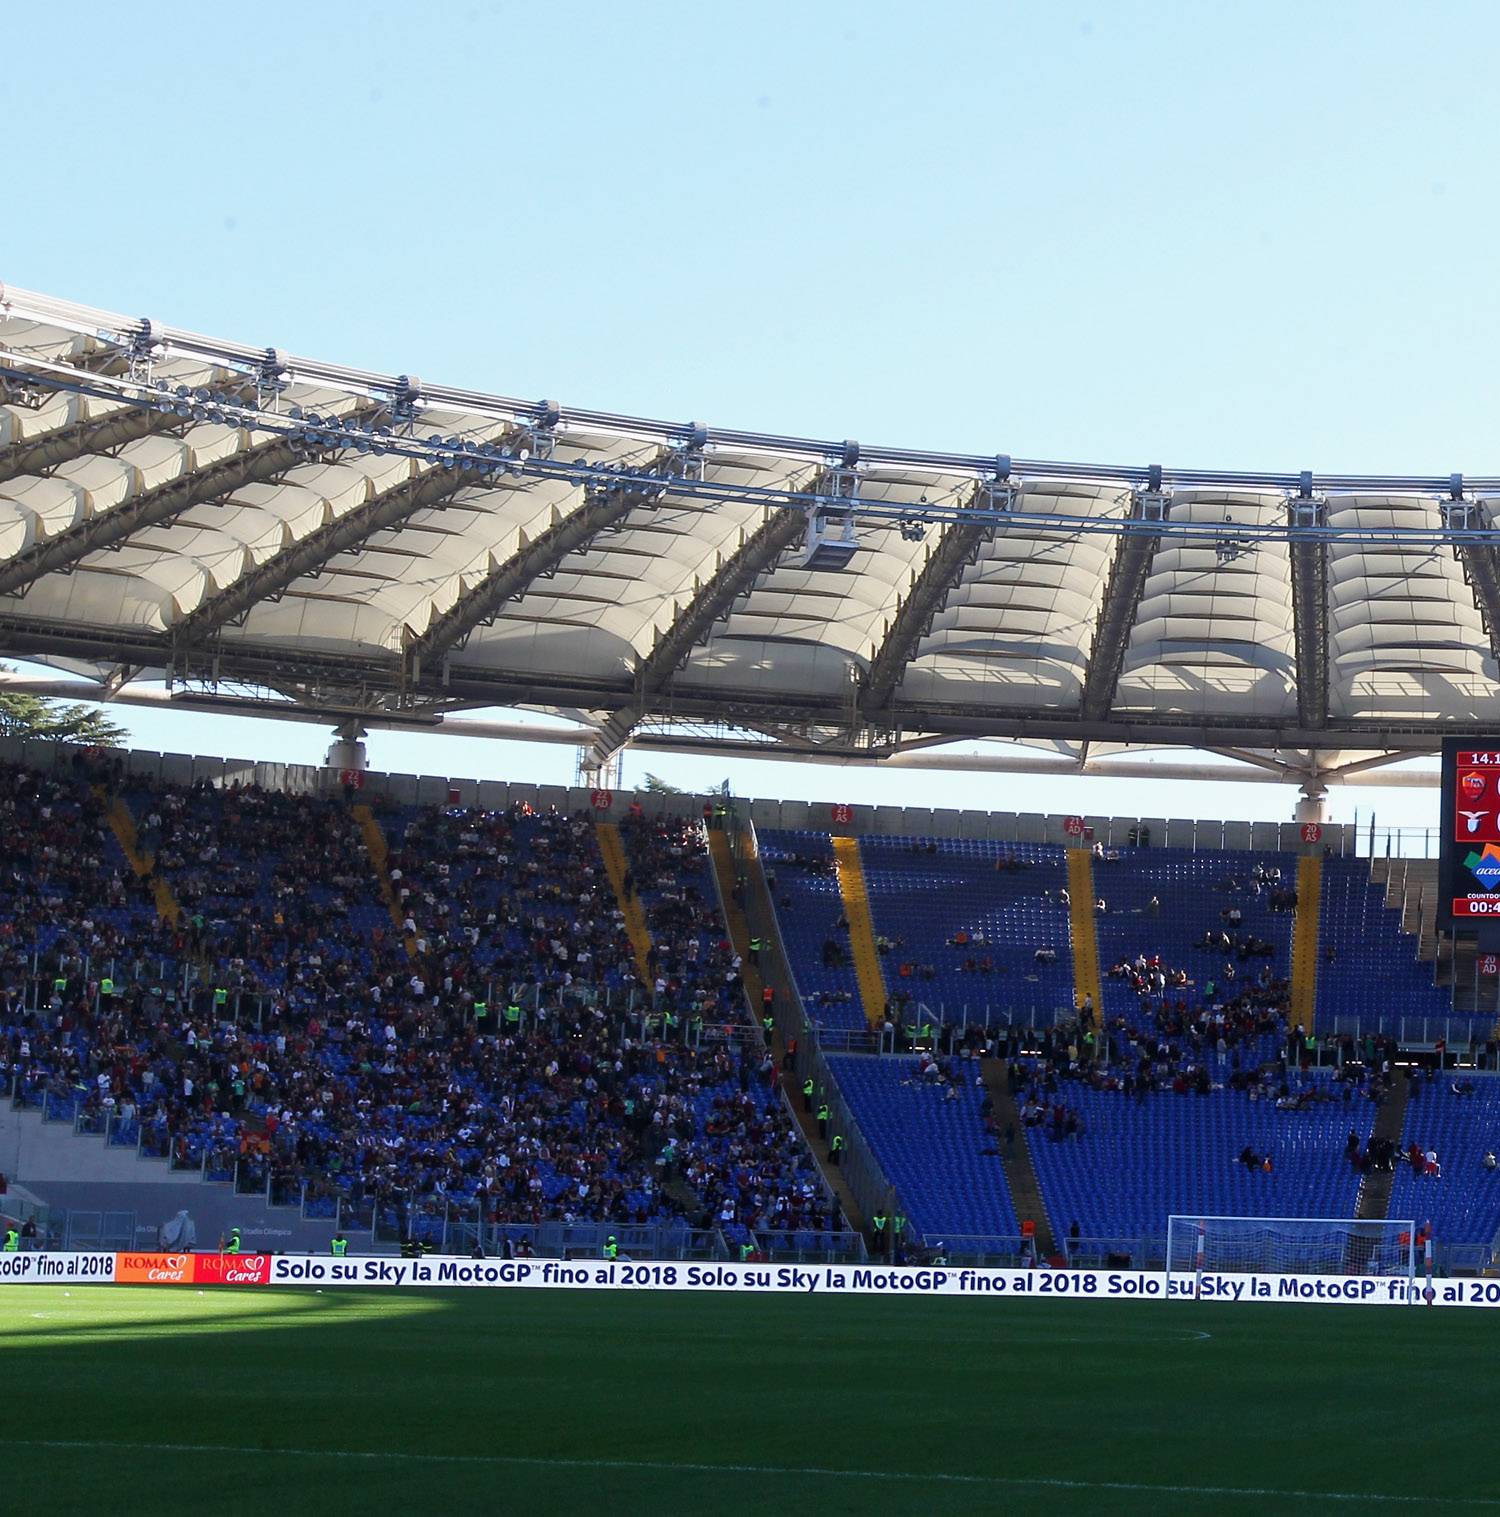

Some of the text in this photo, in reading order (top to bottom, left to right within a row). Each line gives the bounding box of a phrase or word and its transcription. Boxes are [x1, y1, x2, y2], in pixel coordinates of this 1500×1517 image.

[596, 790, 608, 799] 22
[595, 800, 608, 808] AD
[837, 805, 847, 814] 21
[835, 814, 848, 823] AS
[1069, 817, 1079, 825] 21
[1068, 825, 1081, 834] AD
[1306, 824, 1317, 833] 20
[1305, 833, 1317, 842] AS
[1484, 955, 1496, 964] 20
[1483, 964, 1497, 973] AD
[37, 1255, 64, 1276] fino
[67, 1255, 79, 1275] al
[81, 1256, 113, 1275] 2018
[123, 1256, 170, 1269] ROMA
[202, 1258, 247, 1270] ROMA
[148, 1268, 184, 1281] Cares
[226, 1269, 262, 1282] Cares
[275, 1260, 326, 1280] Solo
[331, 1264, 359, 1280] su
[364, 1261, 407, 1286] Sky
[413, 1262, 432, 1281] la
[542, 1264, 590, 1285] fino
[595, 1265, 615, 1285] al
[620, 1265, 678, 1286] 2018
[687, 1266, 738, 1287] Solo
[744, 1271, 771, 1288] su
[777, 1268, 820, 1293] Sky
[826, 1269, 846, 1289] la
[958, 1272, 1007, 1292] fino
[1013, 1272, 1033, 1292] al
[1039, 1273, 1098, 1293] 2018
[1107, 1274, 1160, 1295] Solo
[1168, 1279, 1194, 1295] su
[1200, 1276, 1245, 1301] Sky
[1251, 1277, 1271, 1297] la
[1388, 1280, 1437, 1301] fino
[1443, 1282, 1464, 1302] al
